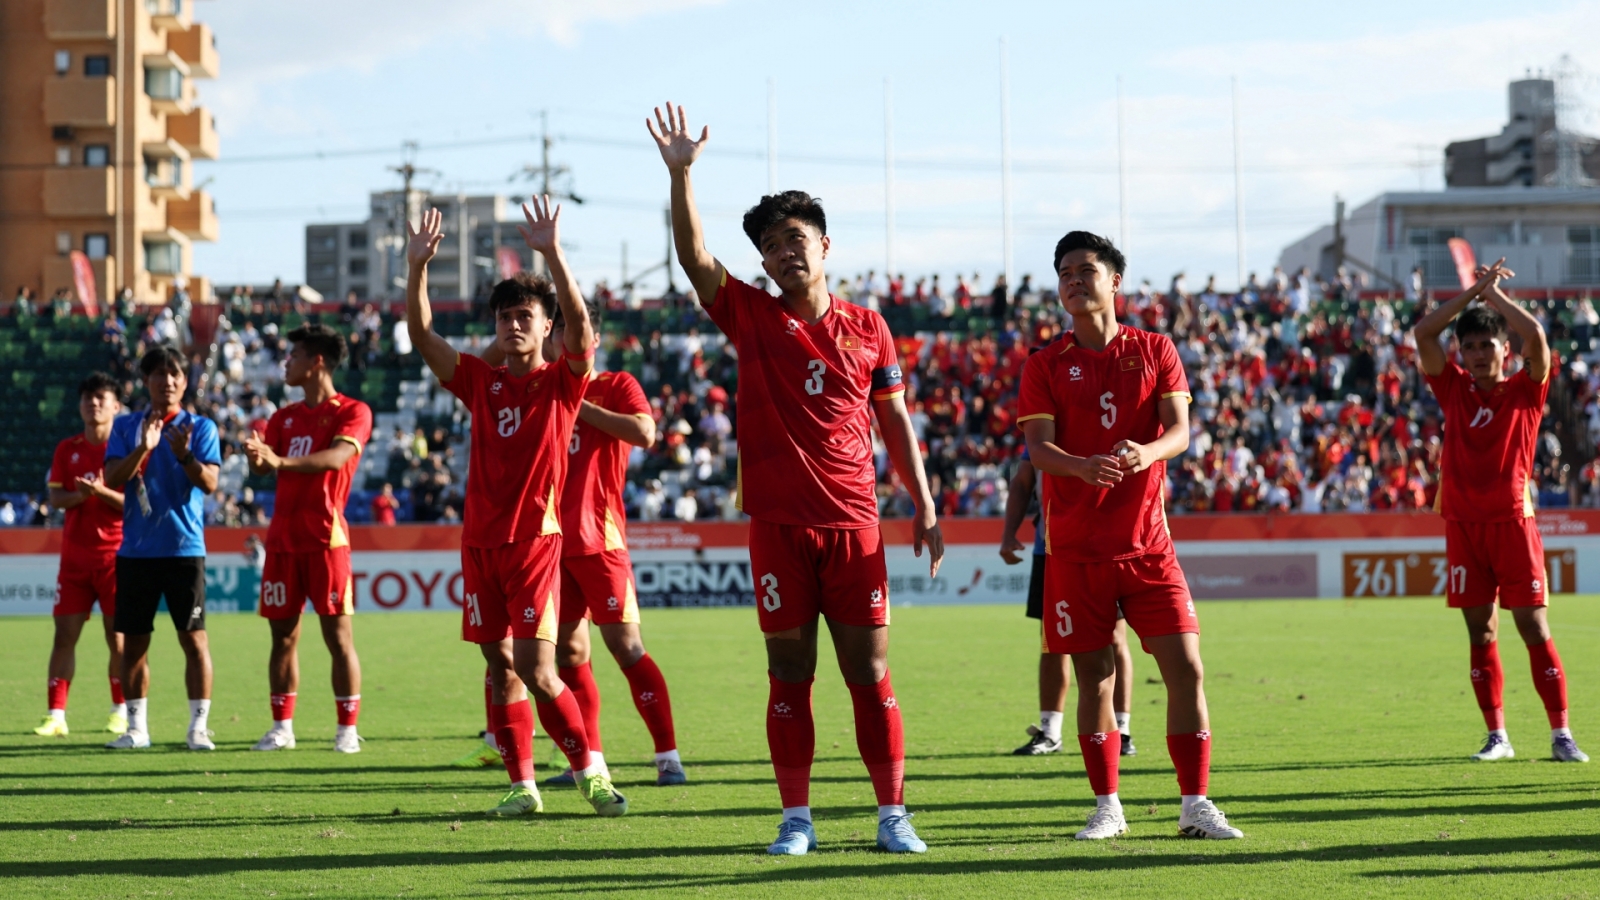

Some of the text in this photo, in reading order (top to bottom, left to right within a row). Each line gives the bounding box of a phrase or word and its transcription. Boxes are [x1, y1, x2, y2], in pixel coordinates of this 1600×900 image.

[804, 358, 826, 396] 3
[497, 406, 521, 438] 21
[1099, 390, 1118, 430] 5
[1469, 405, 1494, 429] 17
[286, 435, 313, 458] 20
[263, 580, 286, 608] 20
[760, 572, 782, 613] 3
[1450, 565, 1467, 595] 17
[465, 592, 483, 627] 21
[1055, 599, 1074, 638] 5
